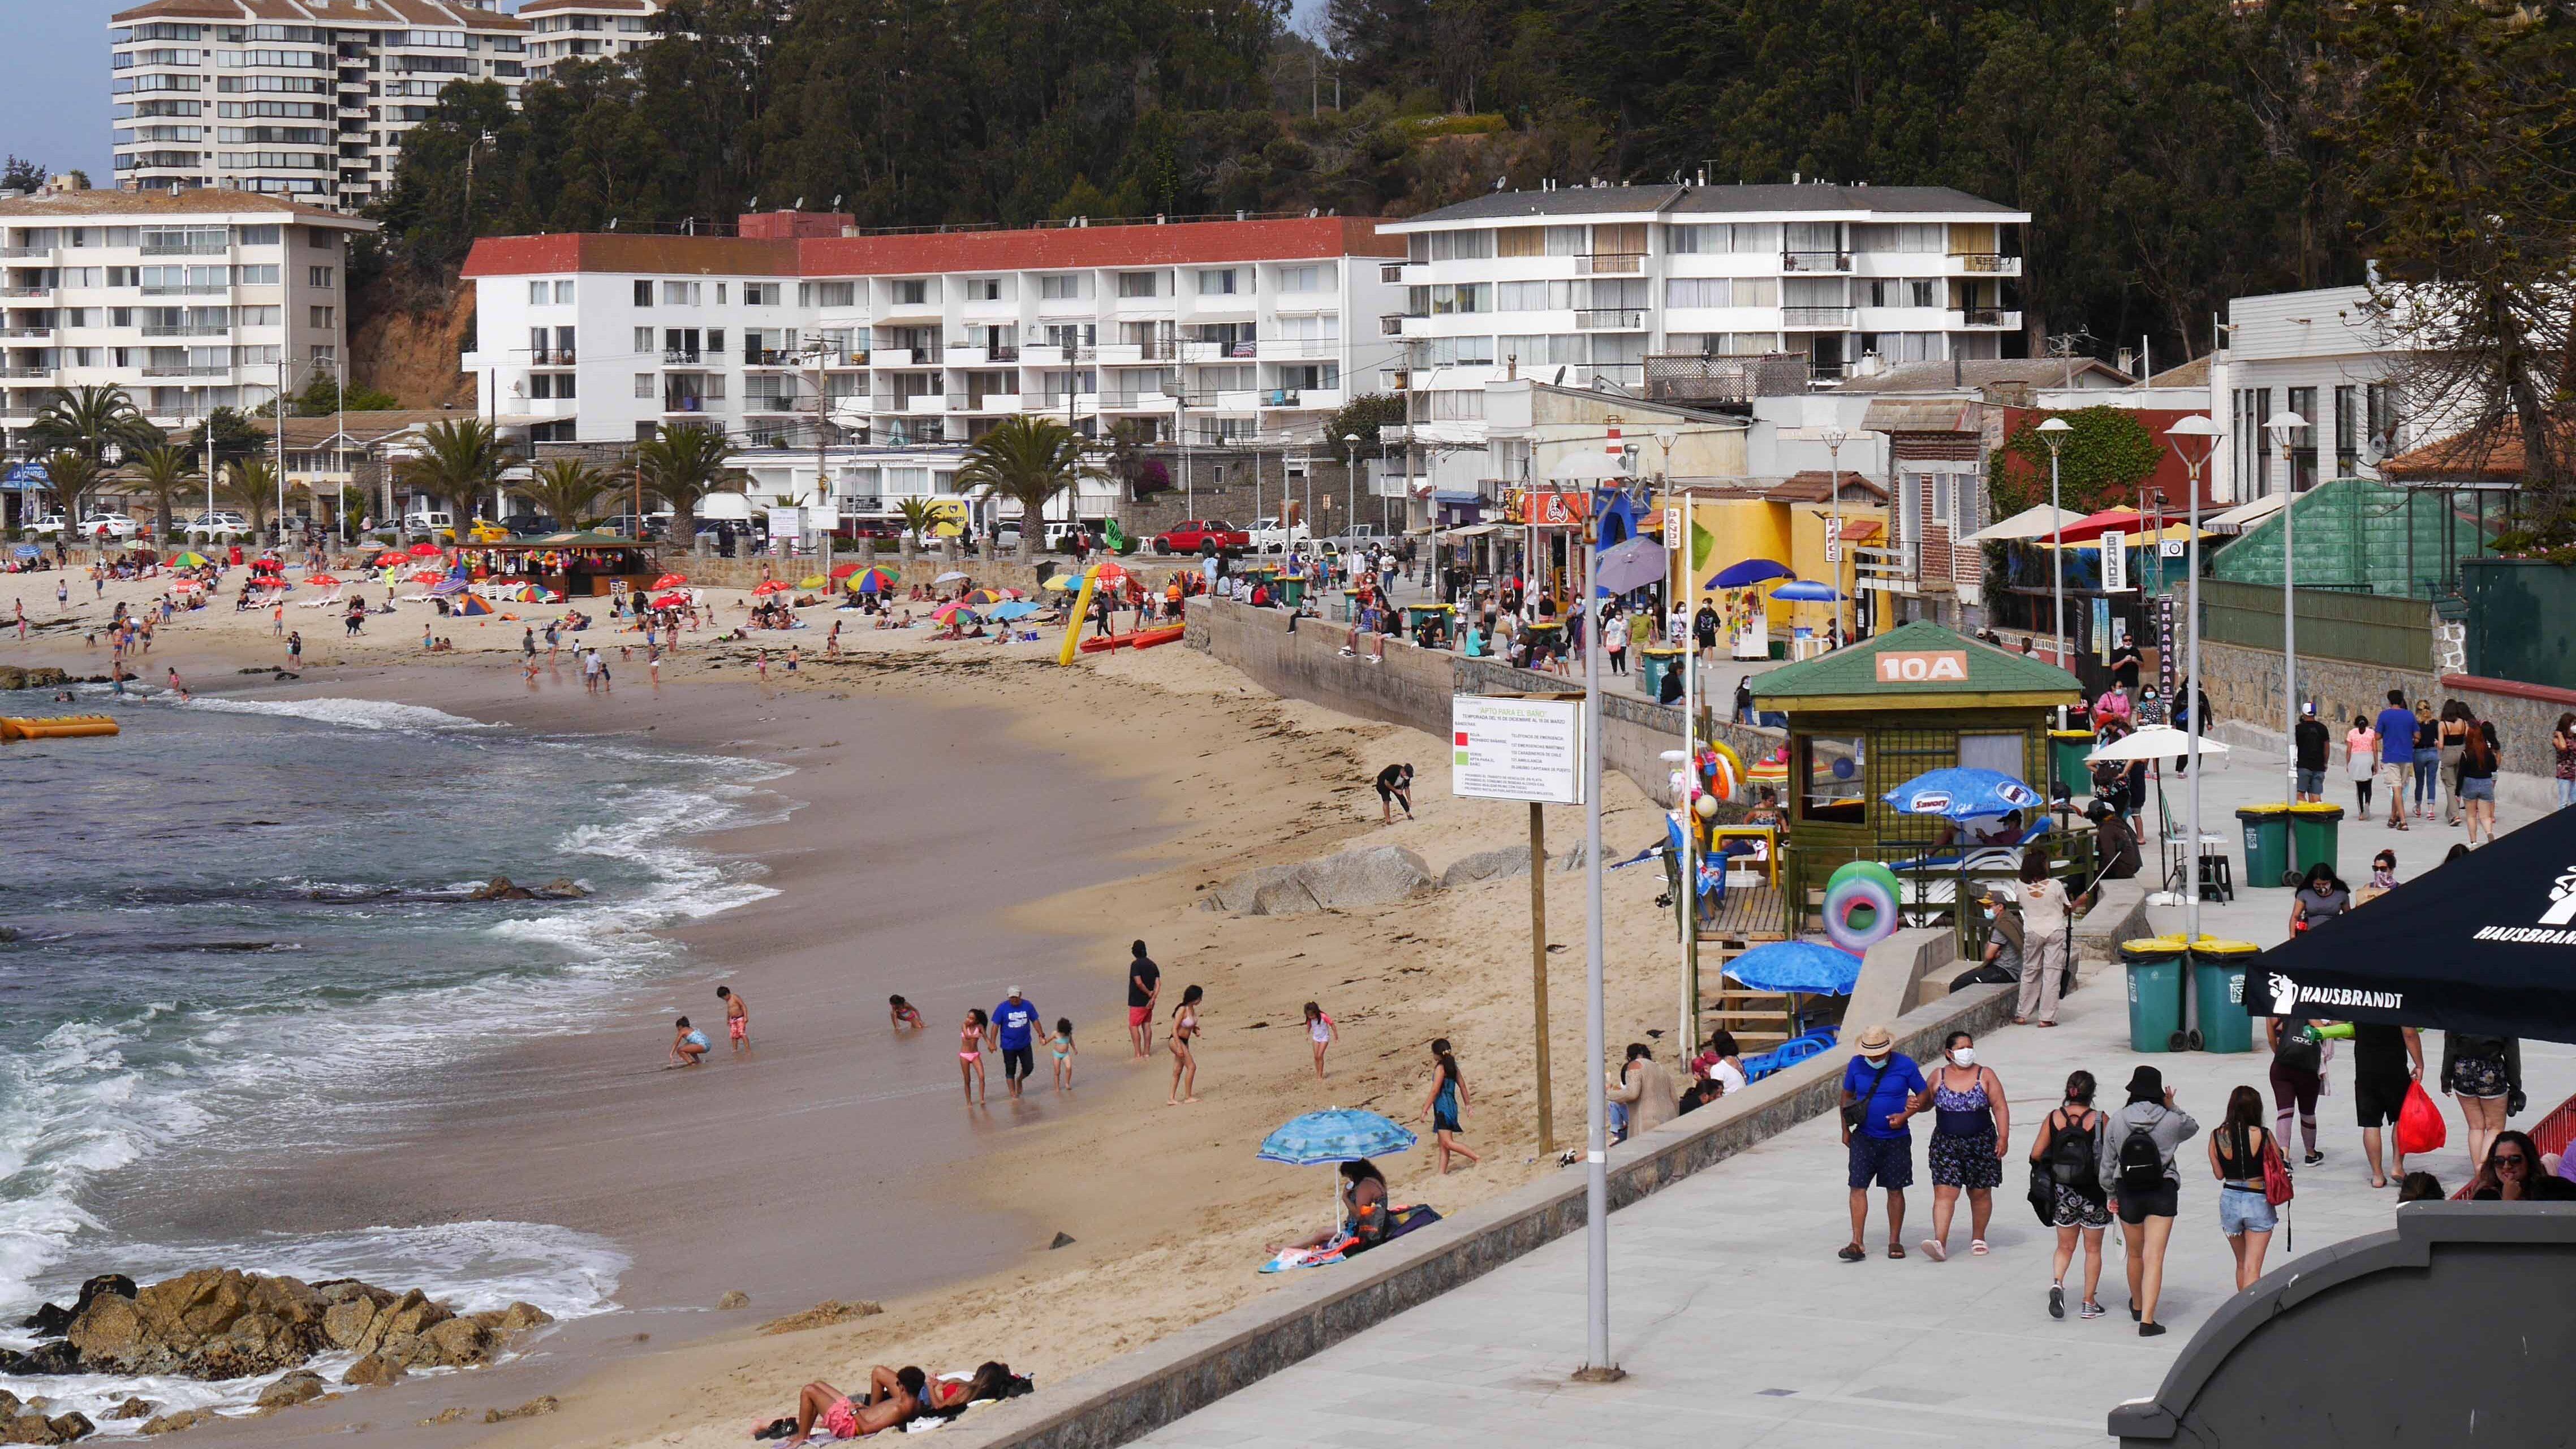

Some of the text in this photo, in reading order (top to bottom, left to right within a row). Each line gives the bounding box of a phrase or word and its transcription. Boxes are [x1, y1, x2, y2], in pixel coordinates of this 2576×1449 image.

[2161, 603, 2171, 694] EMPANADAS
[1883, 657, 1965, 681] 10A
[1916, 799, 1948, 809] Savory
[2299, 986, 2403, 1009] HAUSBRANDT
